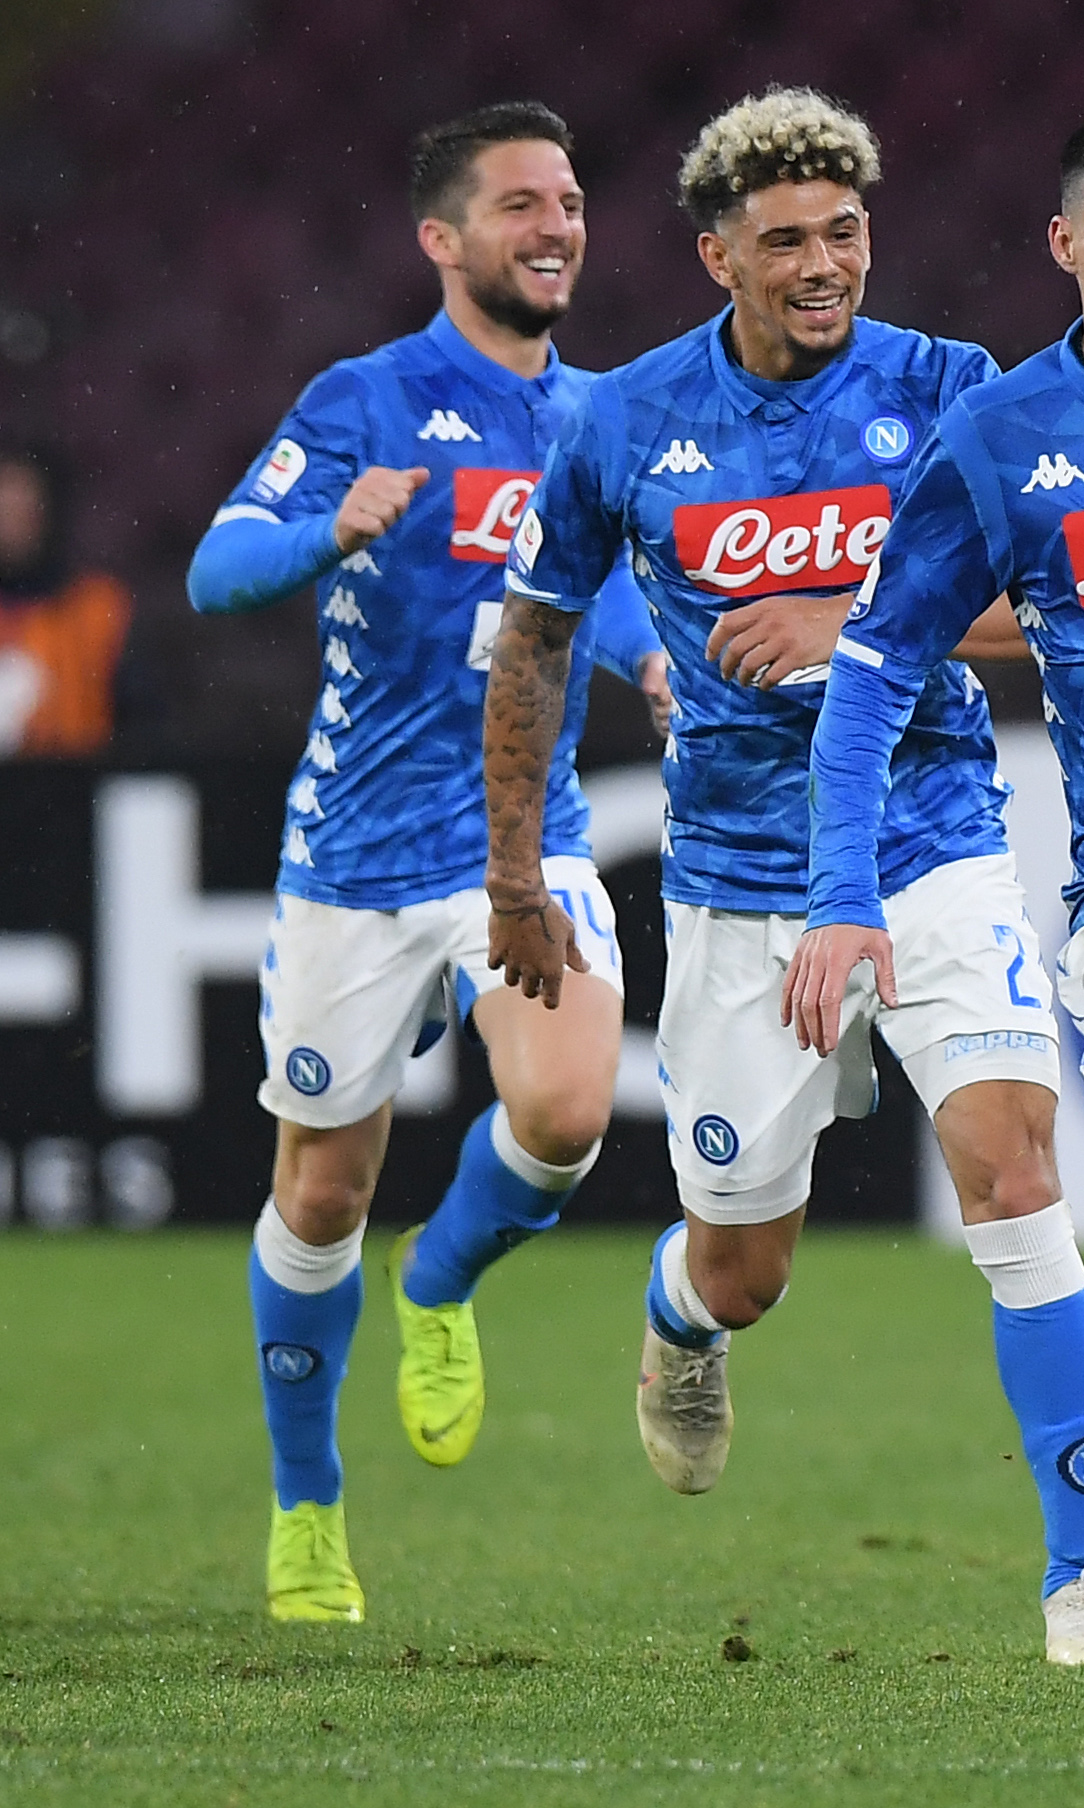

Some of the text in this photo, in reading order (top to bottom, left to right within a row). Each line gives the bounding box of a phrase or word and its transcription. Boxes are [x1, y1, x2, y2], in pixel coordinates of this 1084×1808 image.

[875, 425, 898, 450] N
[685, 504, 891, 589] Lete
[992, 925, 1042, 1009] 2
[945, 1030, 1047, 1062] Kappa
[294, 1057, 318, 1085] N
[703, 1126, 725, 1153] N
